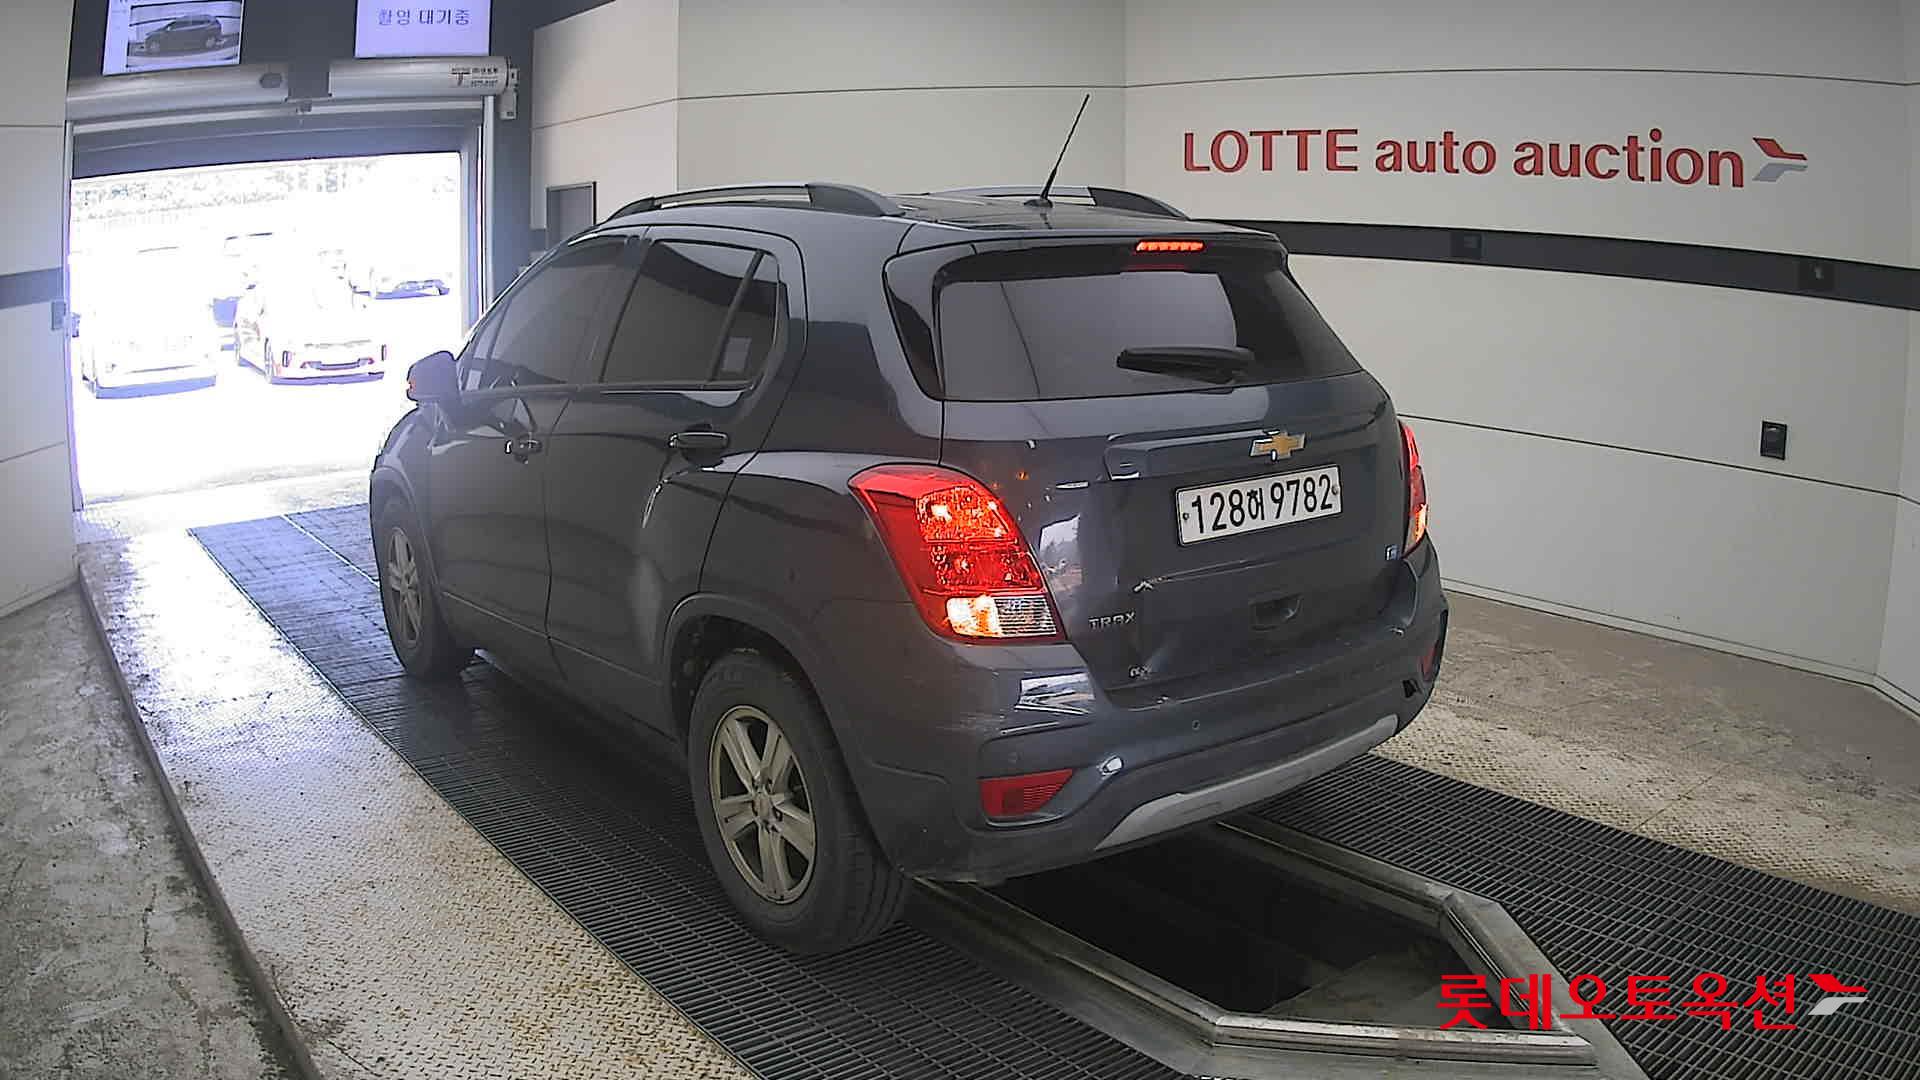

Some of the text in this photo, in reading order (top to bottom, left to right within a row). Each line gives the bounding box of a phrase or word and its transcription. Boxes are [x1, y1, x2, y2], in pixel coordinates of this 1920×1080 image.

[419, 8, 470, 26] 대기중
[1183, 127, 1746, 188] LOTTE auto auction
[1191, 473, 1334, 534] 128허 9782
